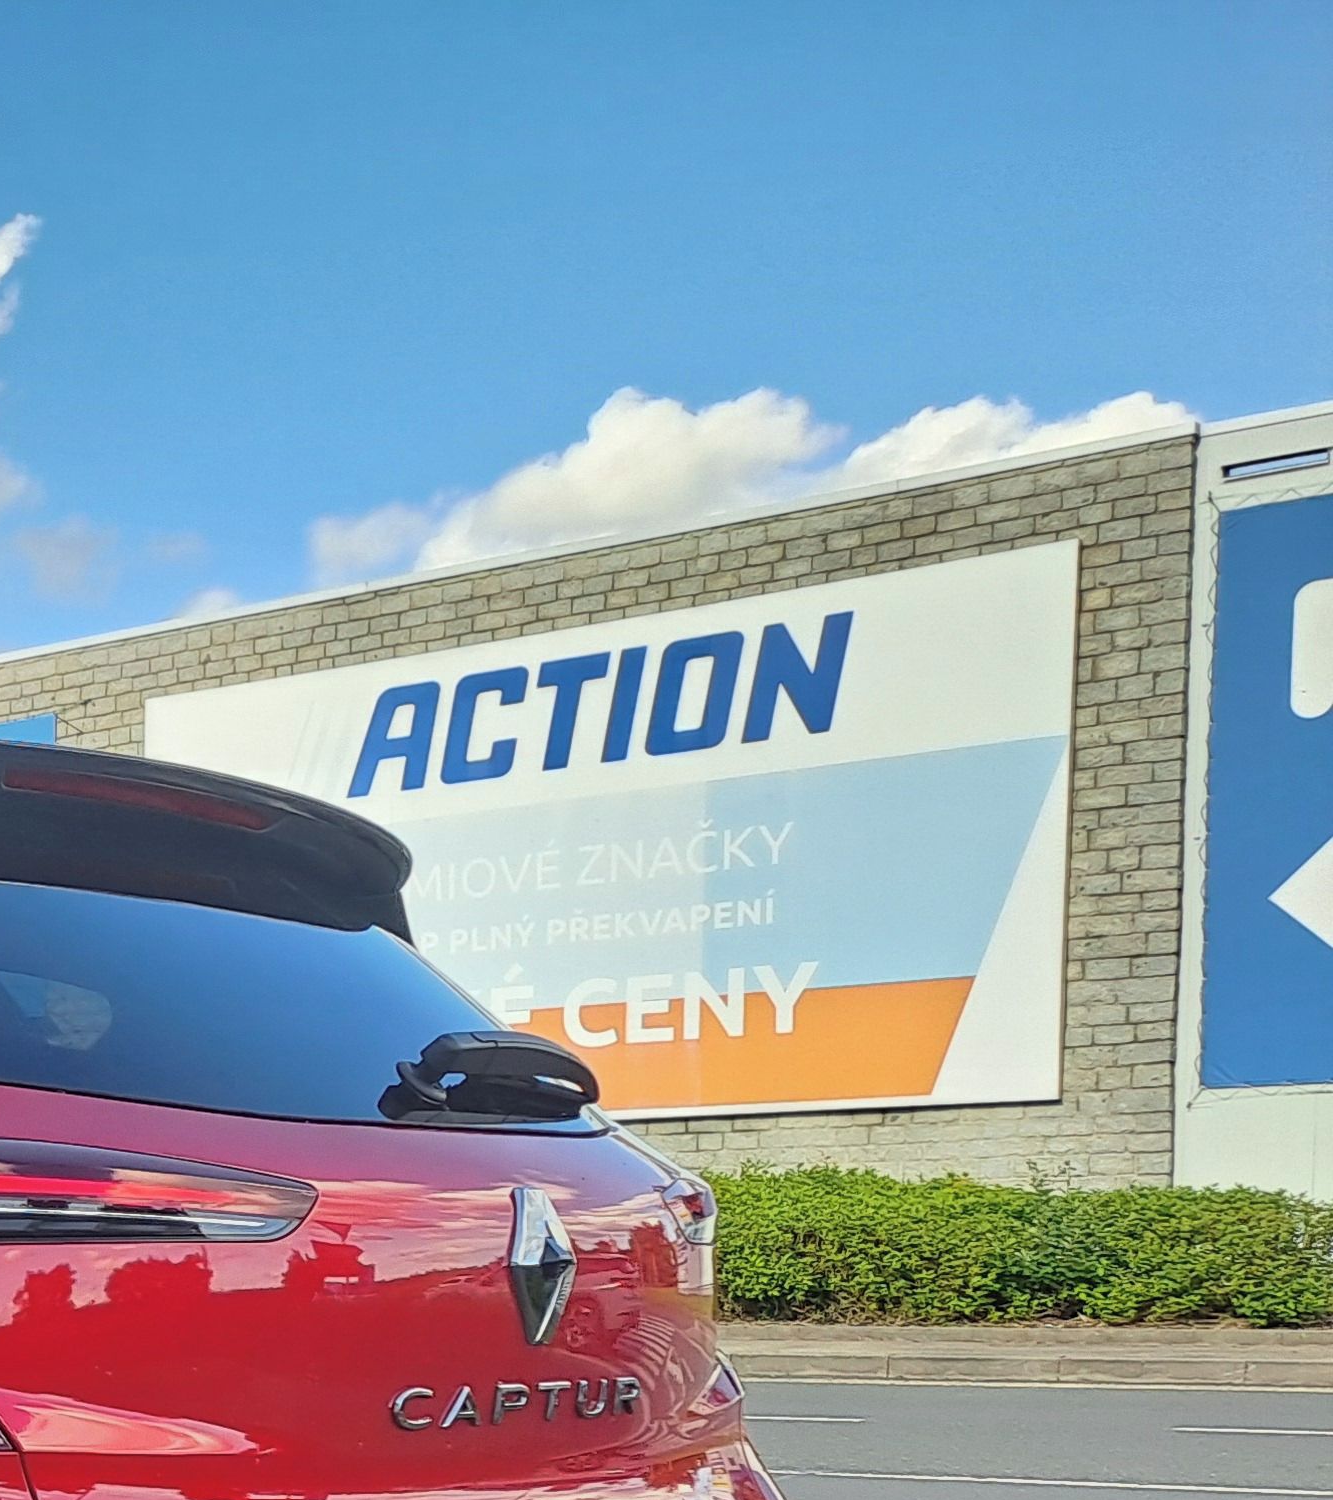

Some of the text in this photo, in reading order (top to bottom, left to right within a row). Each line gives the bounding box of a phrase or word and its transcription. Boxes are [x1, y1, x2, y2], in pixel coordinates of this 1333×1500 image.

[347, 610, 854, 798] ACTION
[410, 818, 795, 902] MIOVÉ ZNAČKY
[450, 915, 535, 954] PLNÝ
[547, 888, 776, 945] PŘEKVAPENÍ
[563, 961, 819, 1048] CENY
[389, 1376, 641, 1431] CAPTUR
